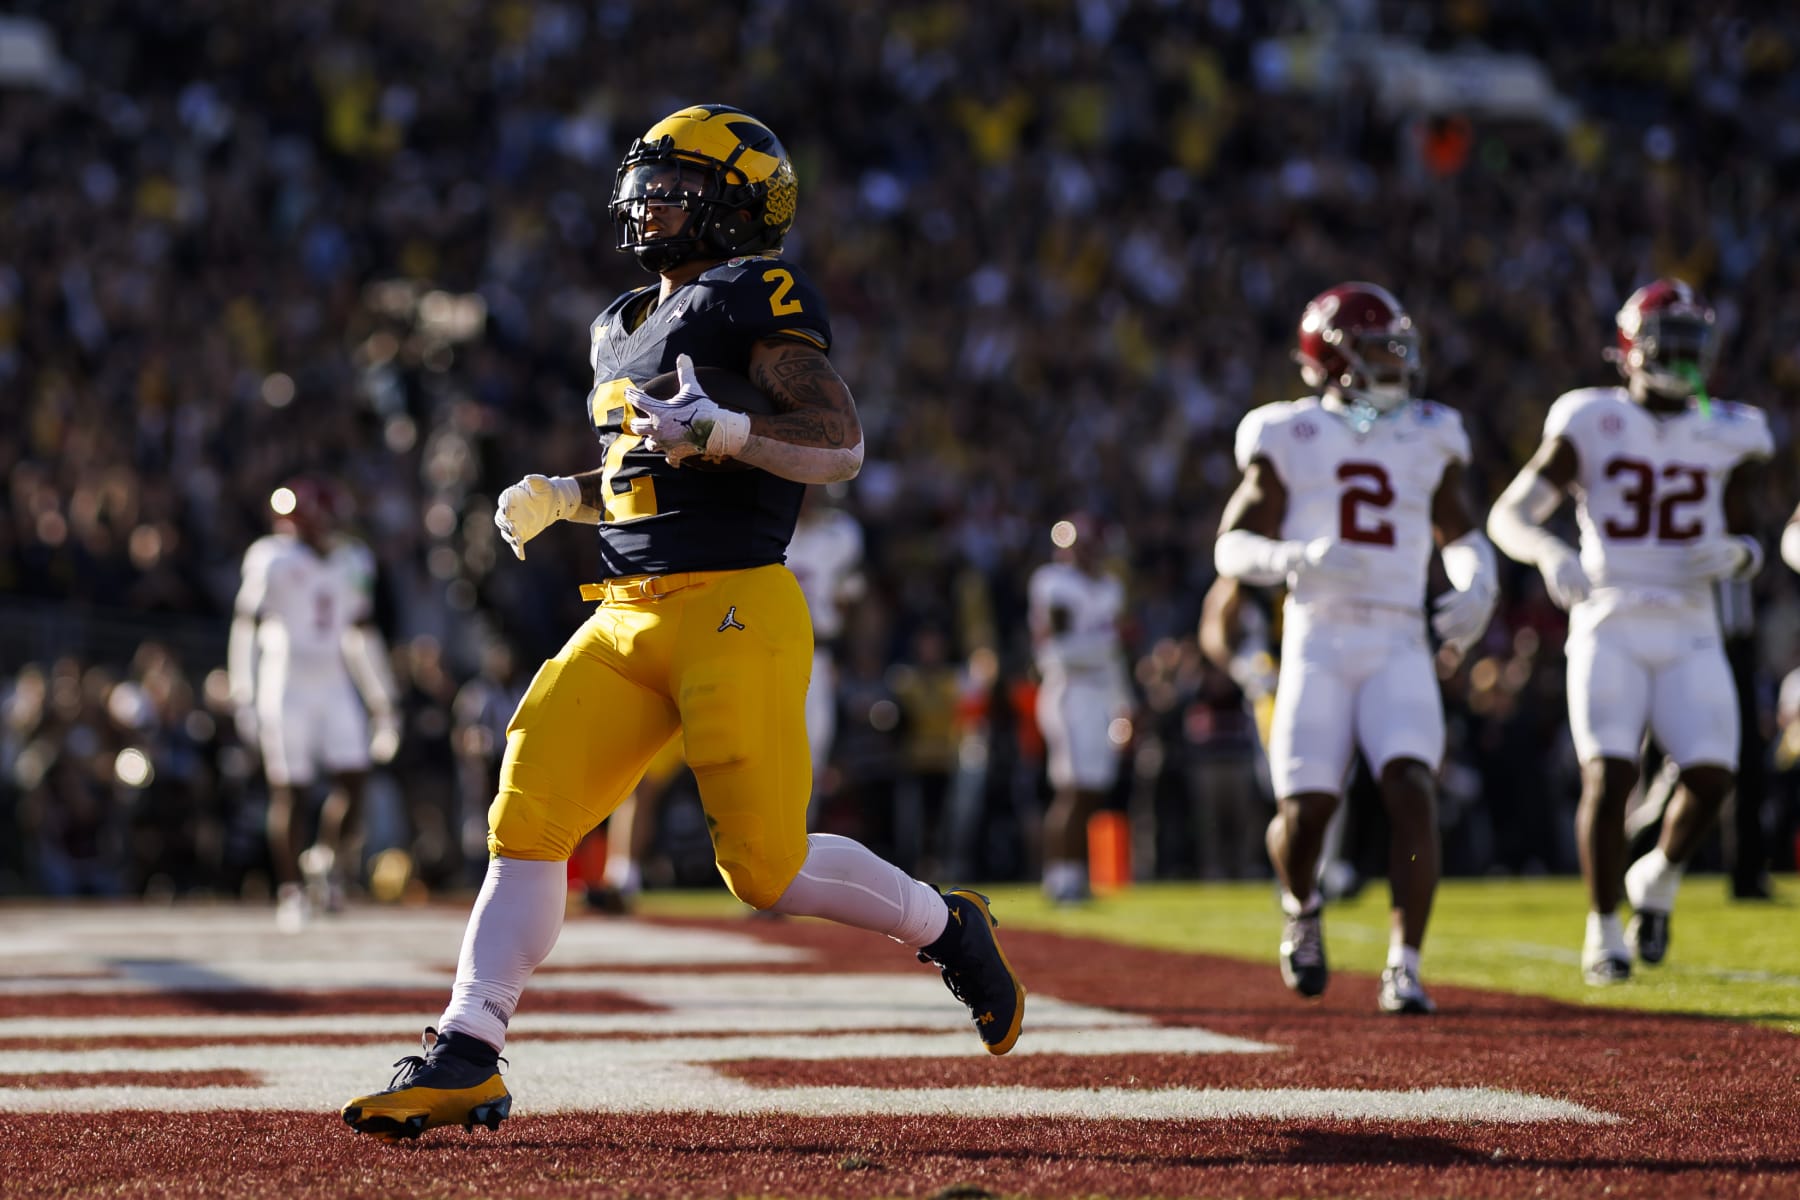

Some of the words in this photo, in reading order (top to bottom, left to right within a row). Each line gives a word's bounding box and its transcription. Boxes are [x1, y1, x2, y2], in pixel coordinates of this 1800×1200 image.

[763, 268, 803, 317] 2
[592, 377, 658, 525] 2
[1336, 463, 1396, 547] 2
[1604, 456, 1709, 542] 32
[979, 1010, 995, 1025] M
